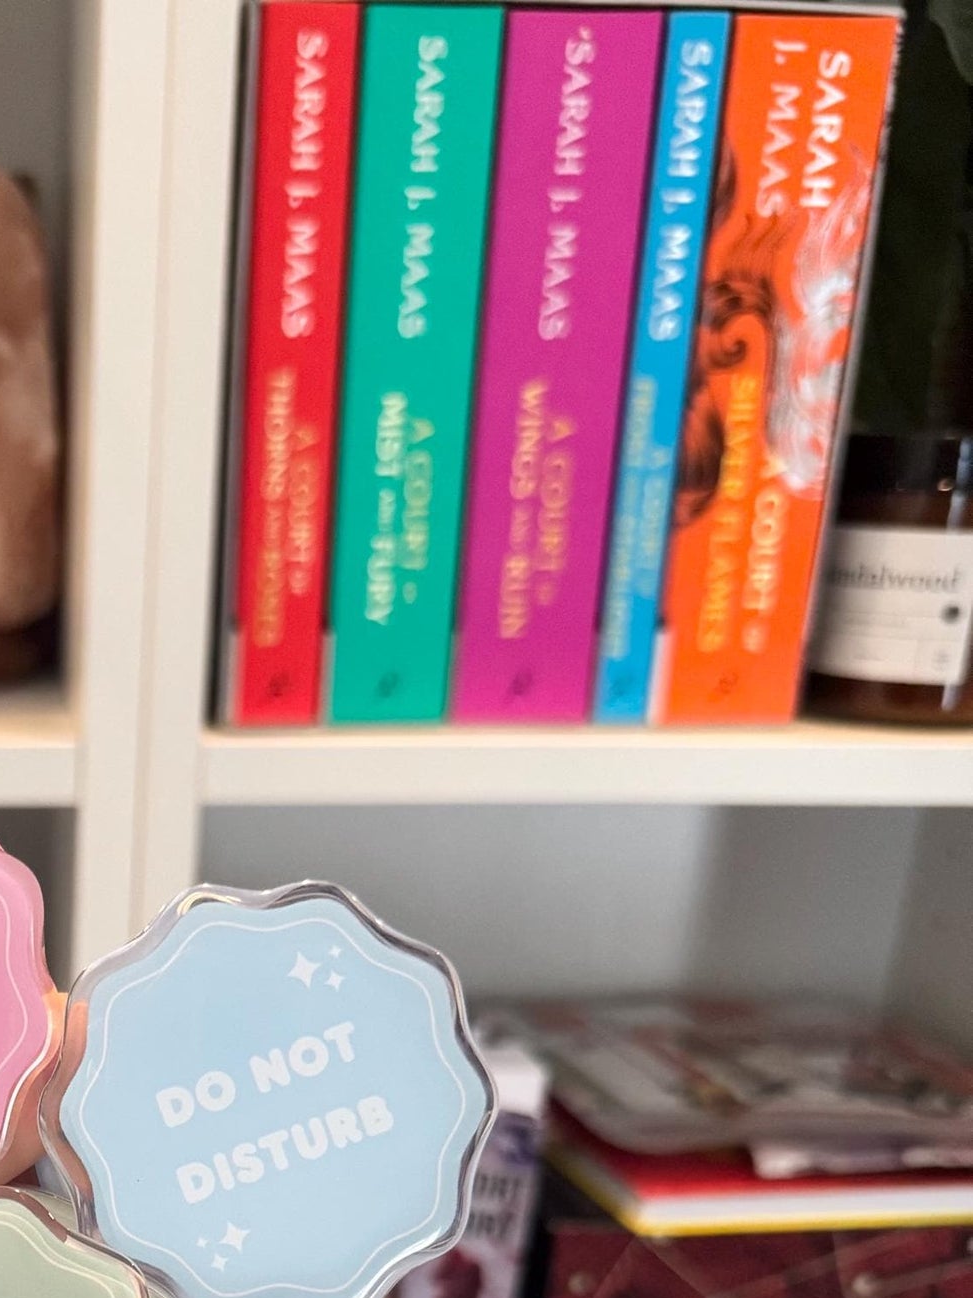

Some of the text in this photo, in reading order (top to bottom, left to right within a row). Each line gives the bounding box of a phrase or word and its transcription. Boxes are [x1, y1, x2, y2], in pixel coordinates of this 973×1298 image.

[290, 27, 329, 172] SARAH
[409, 34, 449, 172] SARAH
[667, 37, 714, 178] SARAH
[755, 82, 802, 218] MAAS
[799, 50, 851, 207] SARAH
[280, 214, 320, 339] MAAS
[397, 221, 435, 339] MAAS
[538, 221, 579, 341] MAAS
[648, 224, 692, 341] MAAS
[155, 1022, 357, 1129] DO NOT
[176, 1095, 395, 1204] DISTURB
